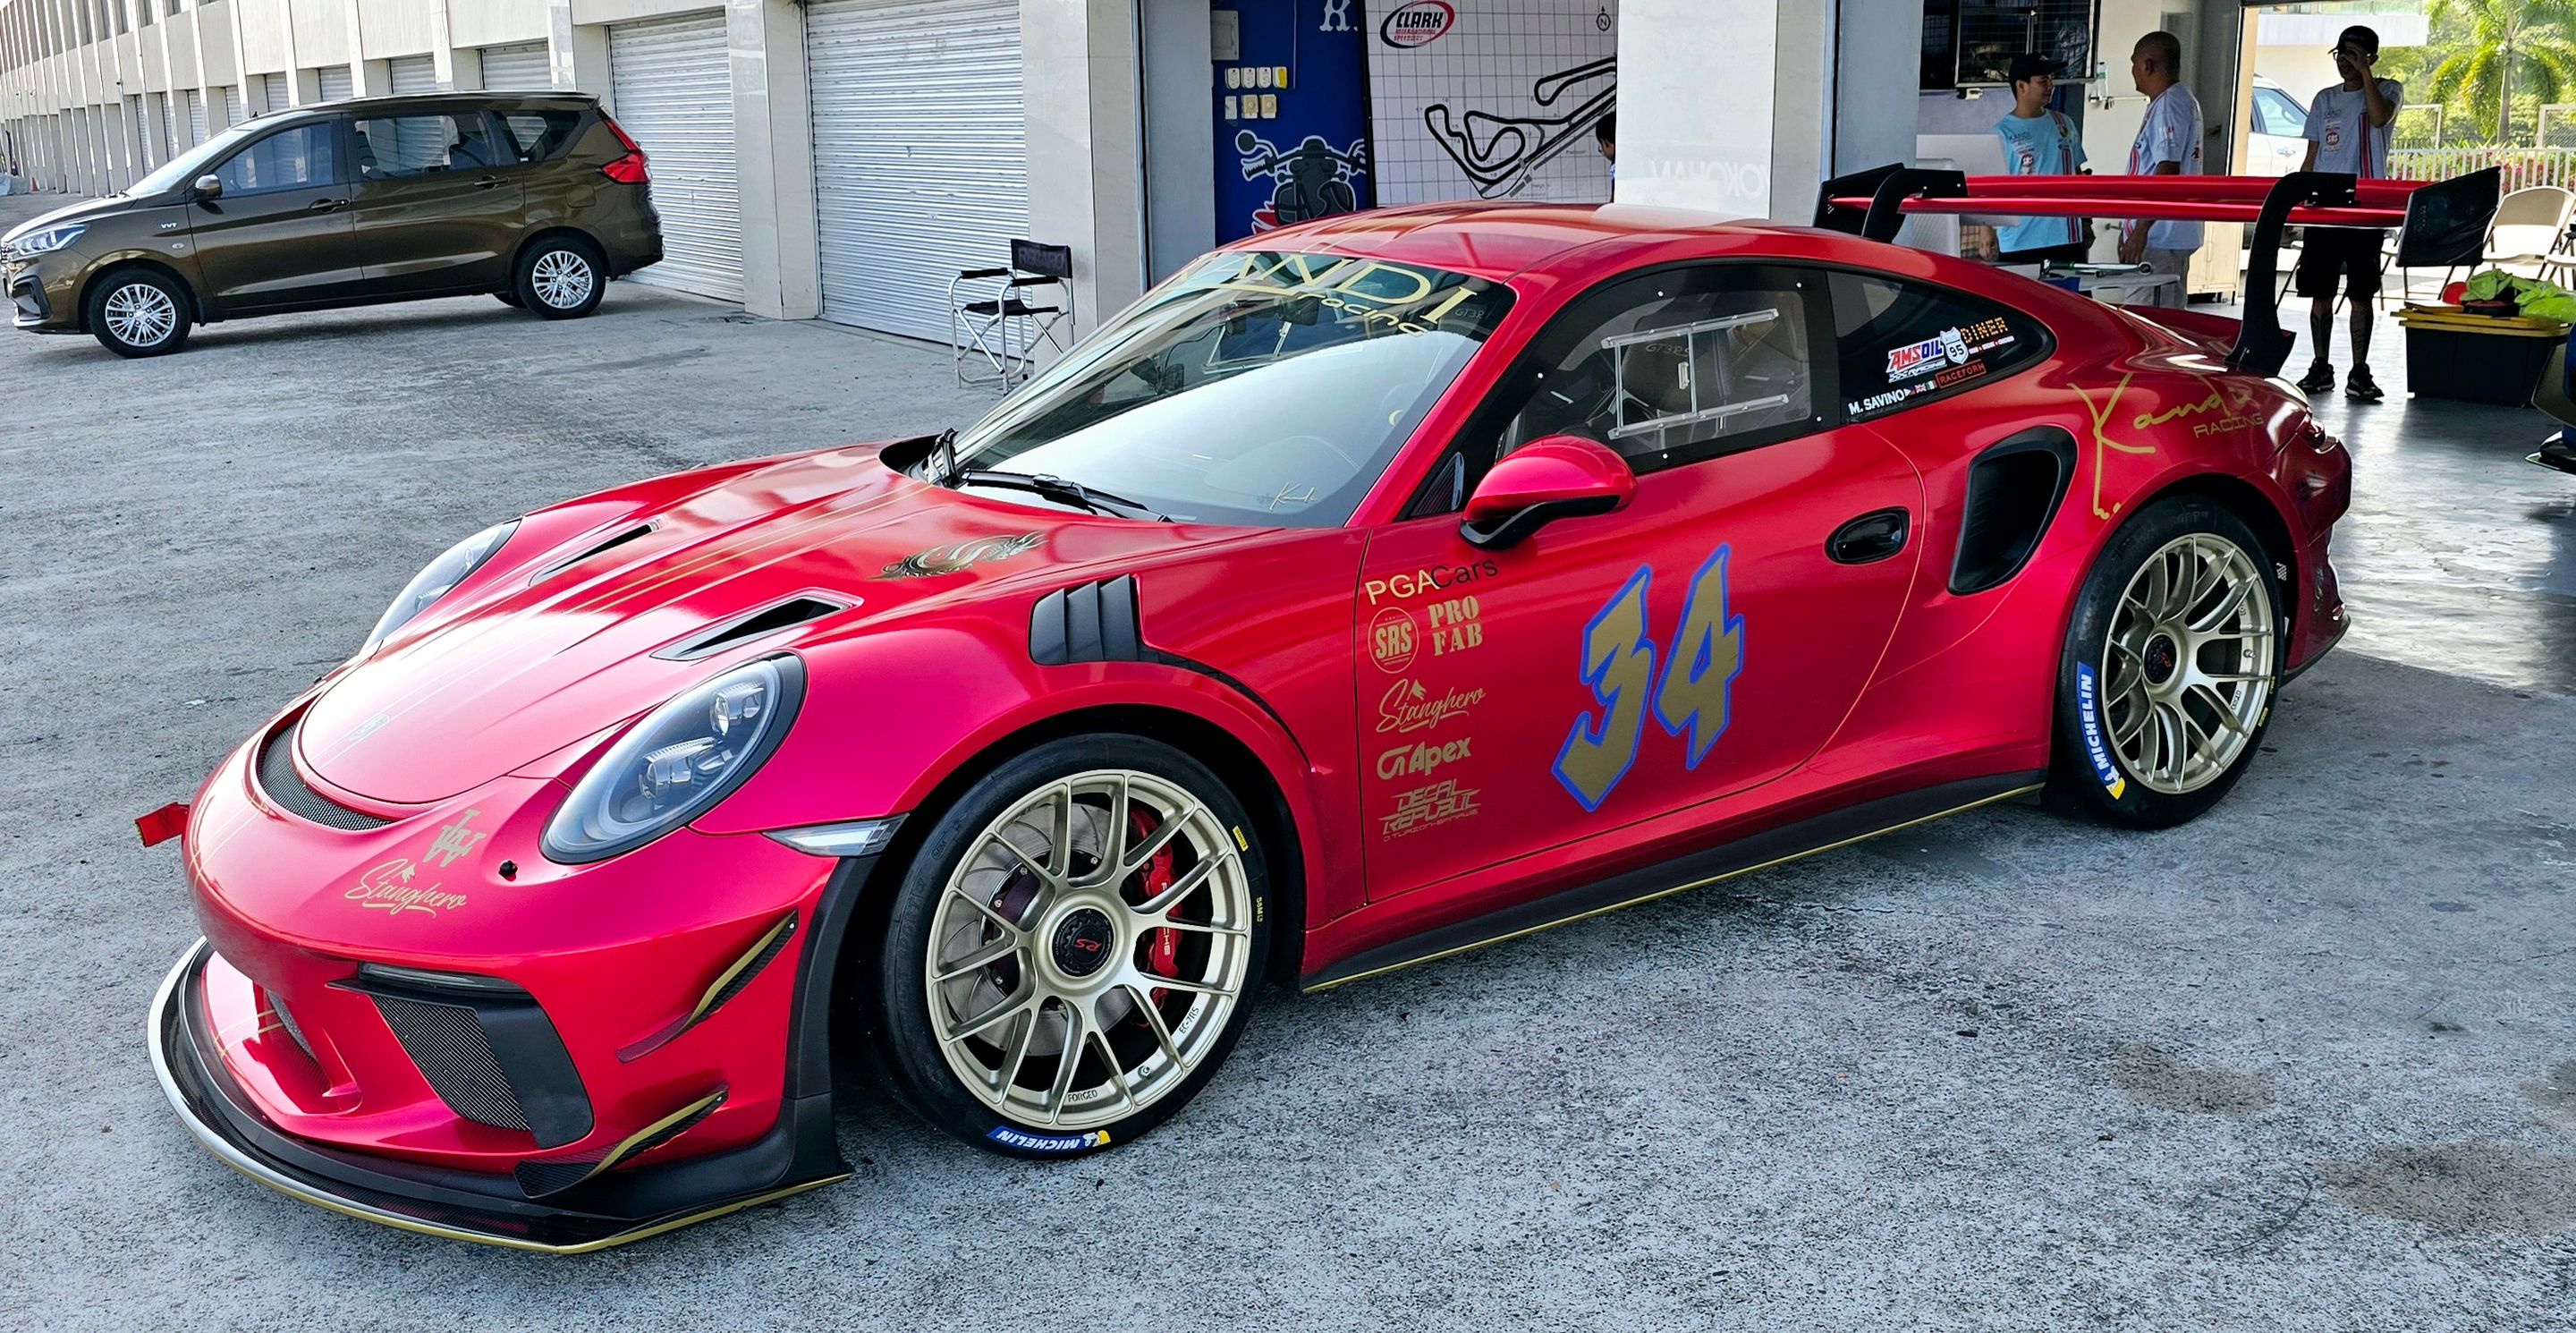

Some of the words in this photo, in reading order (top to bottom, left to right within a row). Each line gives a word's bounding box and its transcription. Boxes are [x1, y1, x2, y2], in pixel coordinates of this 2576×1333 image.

[1396, 12, 1445, 28] CLARK
[1960, 317, 2009, 344] DINER
[1888, 339, 1945, 371] AMSOIL
[1949, 344, 1965, 358] 95
[1938, 361, 1986, 385] RACEFORM
[1848, 401, 1863, 415] M.
[1864, 388, 1905, 411] SAVINO
[2193, 412, 2265, 438] RACING
[1428, 595, 1479, 629] PRO
[1375, 622, 1413, 659] SRS
[1432, 623, 1484, 657] FAB
[1551, 542, 1745, 813] 34
[1376, 678, 1487, 733] Stanghero
[2080, 674, 2111, 771] MICHELIN
[1392, 778, 1473, 811] DECAL
[1377, 789, 1482, 836] REPUBLIC
[344, 858, 468, 918] Stanghero
[1178, 1006, 1200, 1036] EC-7RS
[1067, 1089, 1098, 1102] FORGED
[996, 1129, 1080, 1150] MICHELIN
